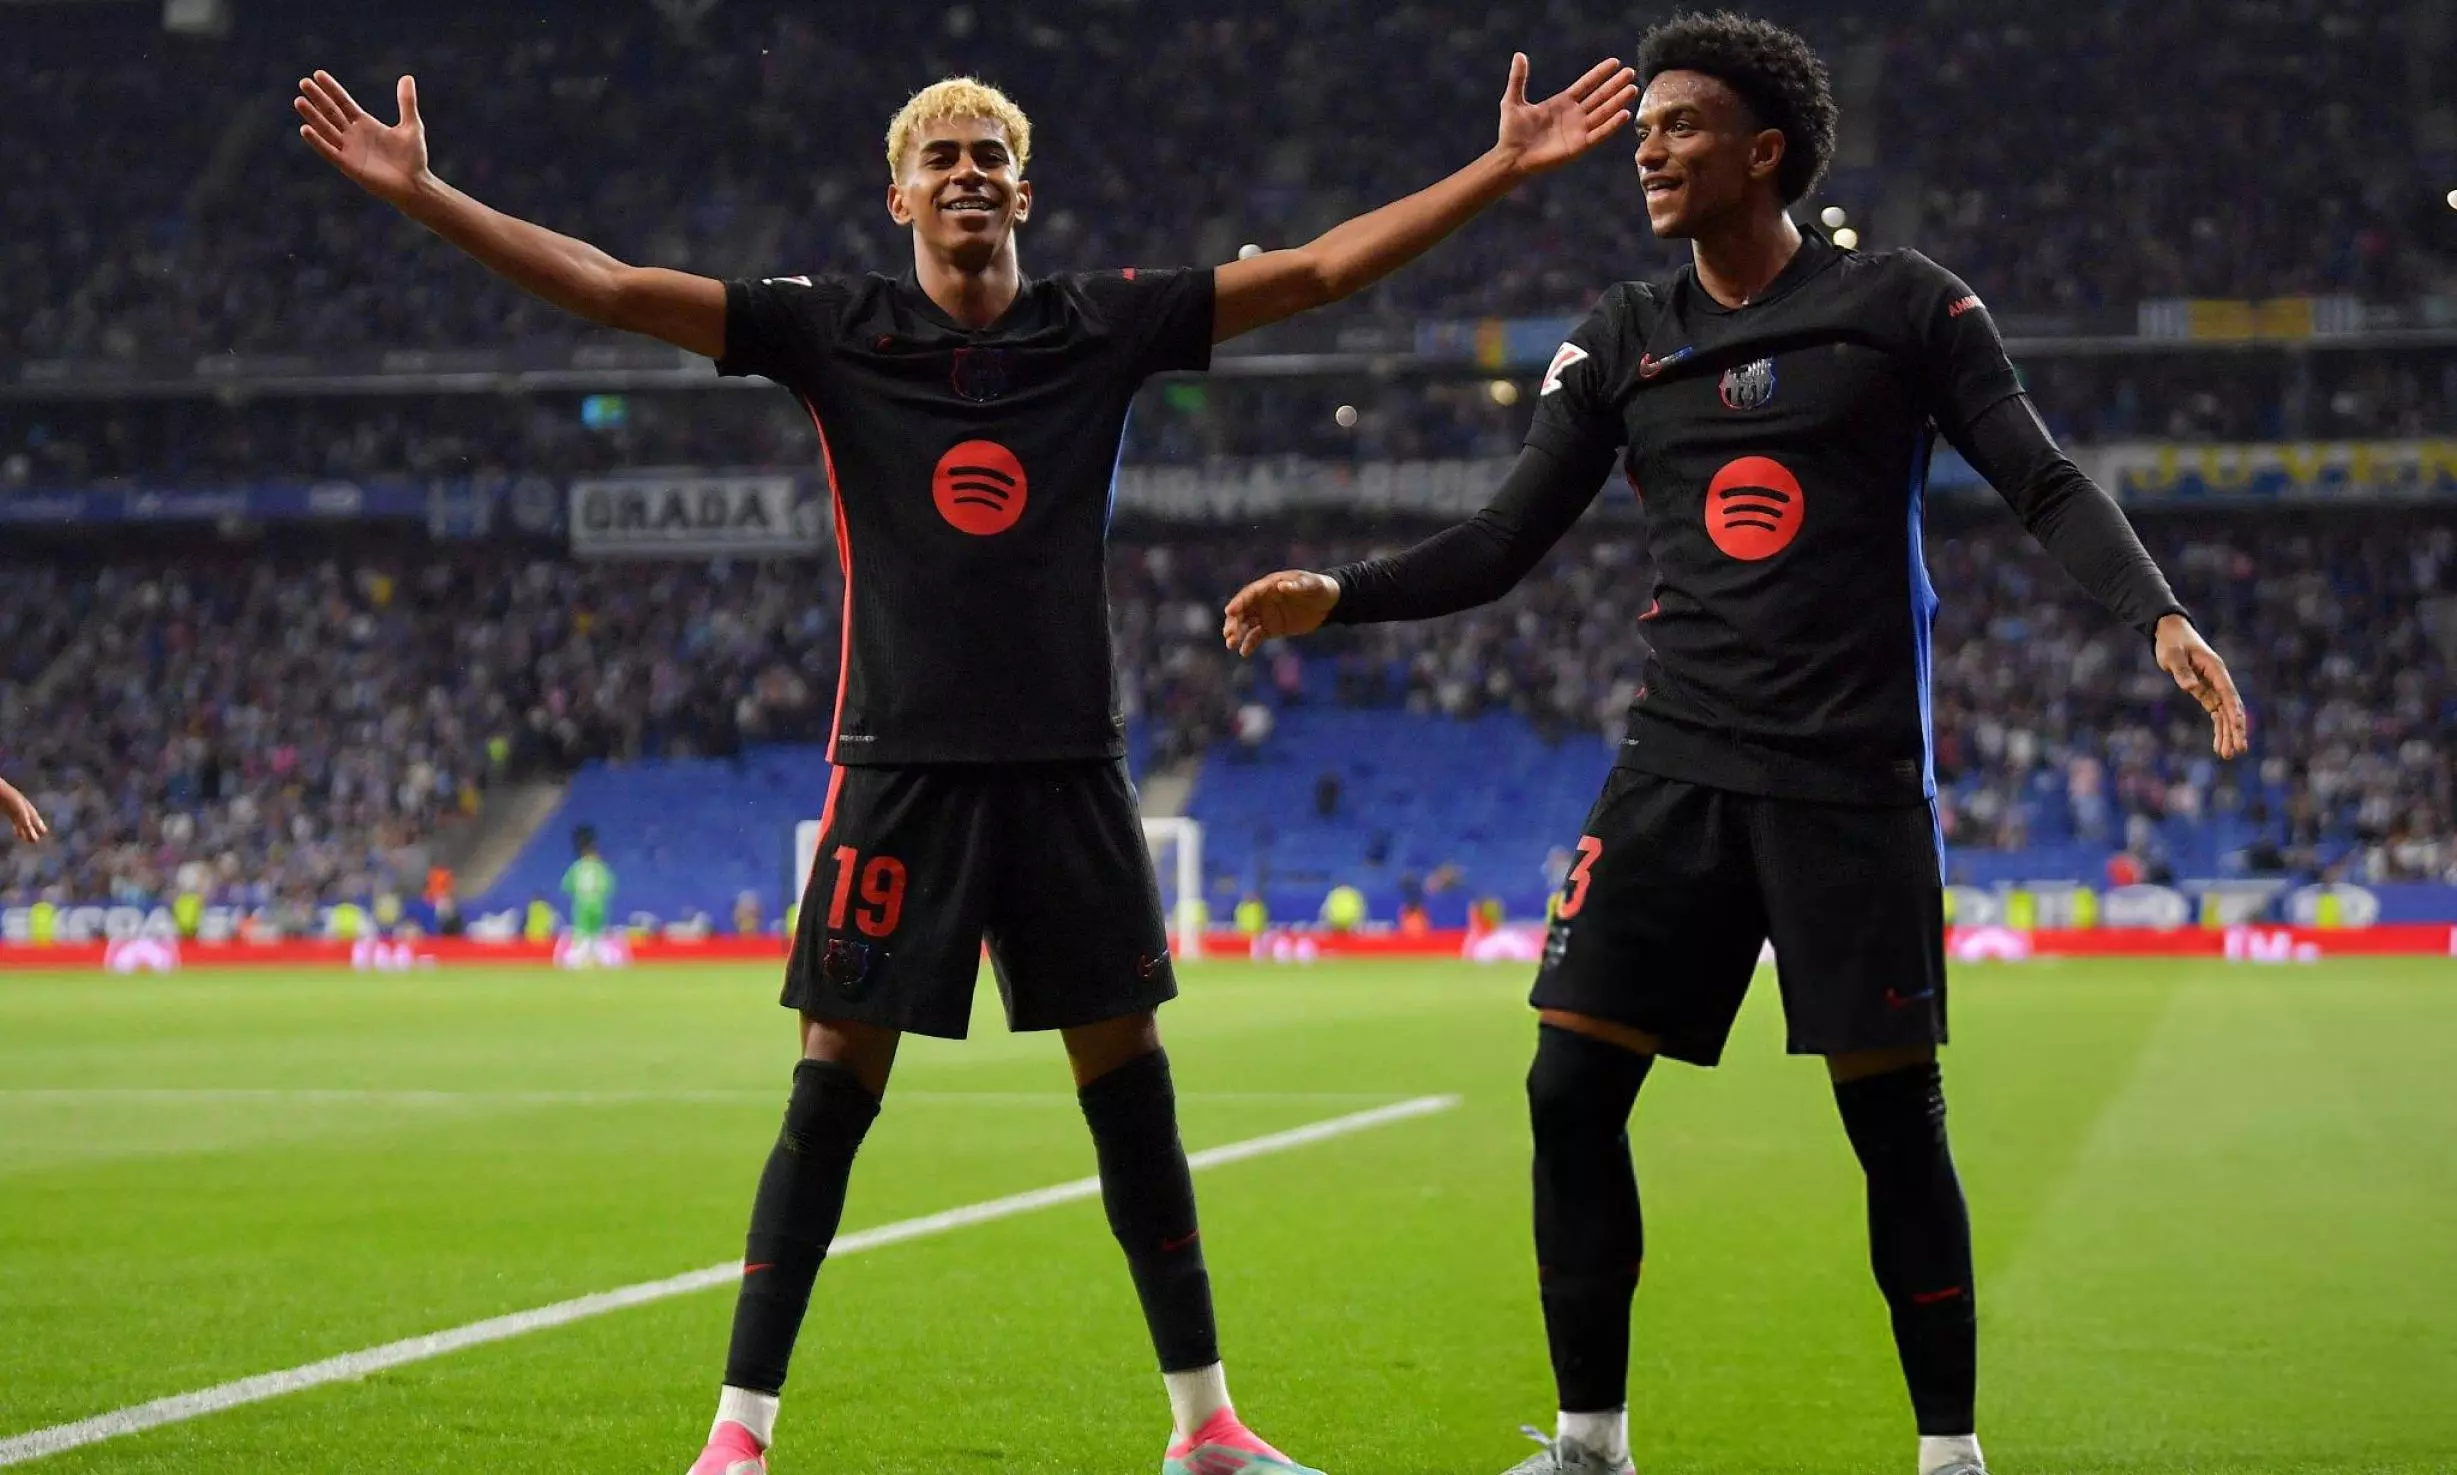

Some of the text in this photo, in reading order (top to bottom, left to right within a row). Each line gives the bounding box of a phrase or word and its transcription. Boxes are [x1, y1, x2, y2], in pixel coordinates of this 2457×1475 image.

[582, 488, 771, 530] GRADA
[827, 844, 907, 937] 19
[1557, 834, 1603, 920] 3
